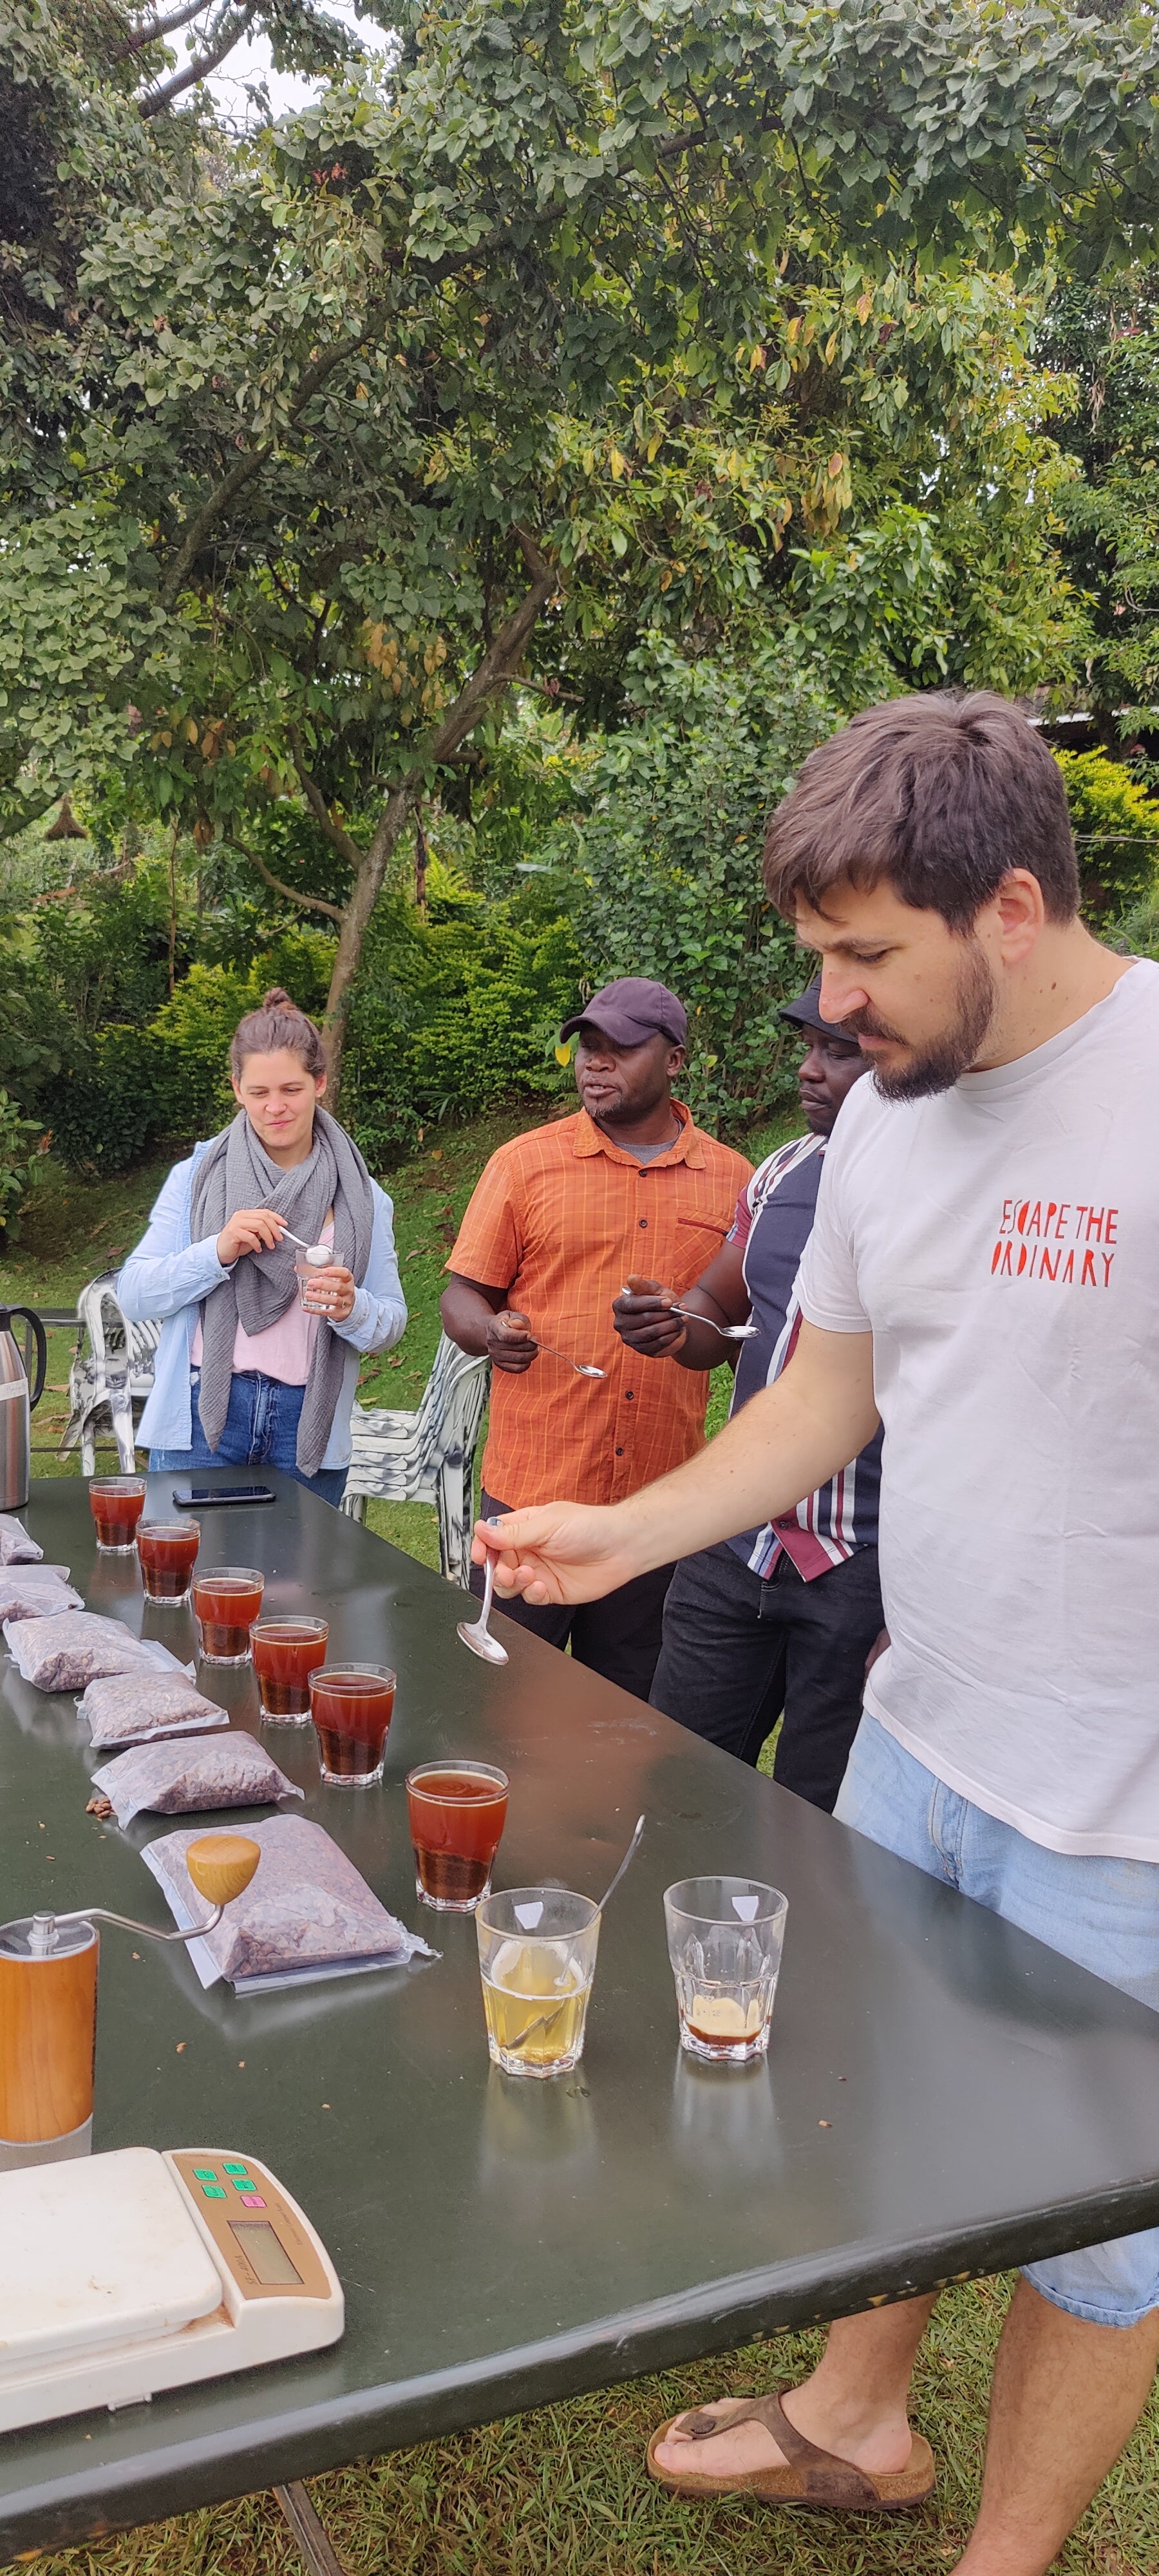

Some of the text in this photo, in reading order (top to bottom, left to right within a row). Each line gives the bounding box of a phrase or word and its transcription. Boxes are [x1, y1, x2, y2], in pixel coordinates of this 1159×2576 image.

[999, 1198, 1118, 1244] ESCAPE THE
[990, 1240, 1115, 1288] ORDINARY
